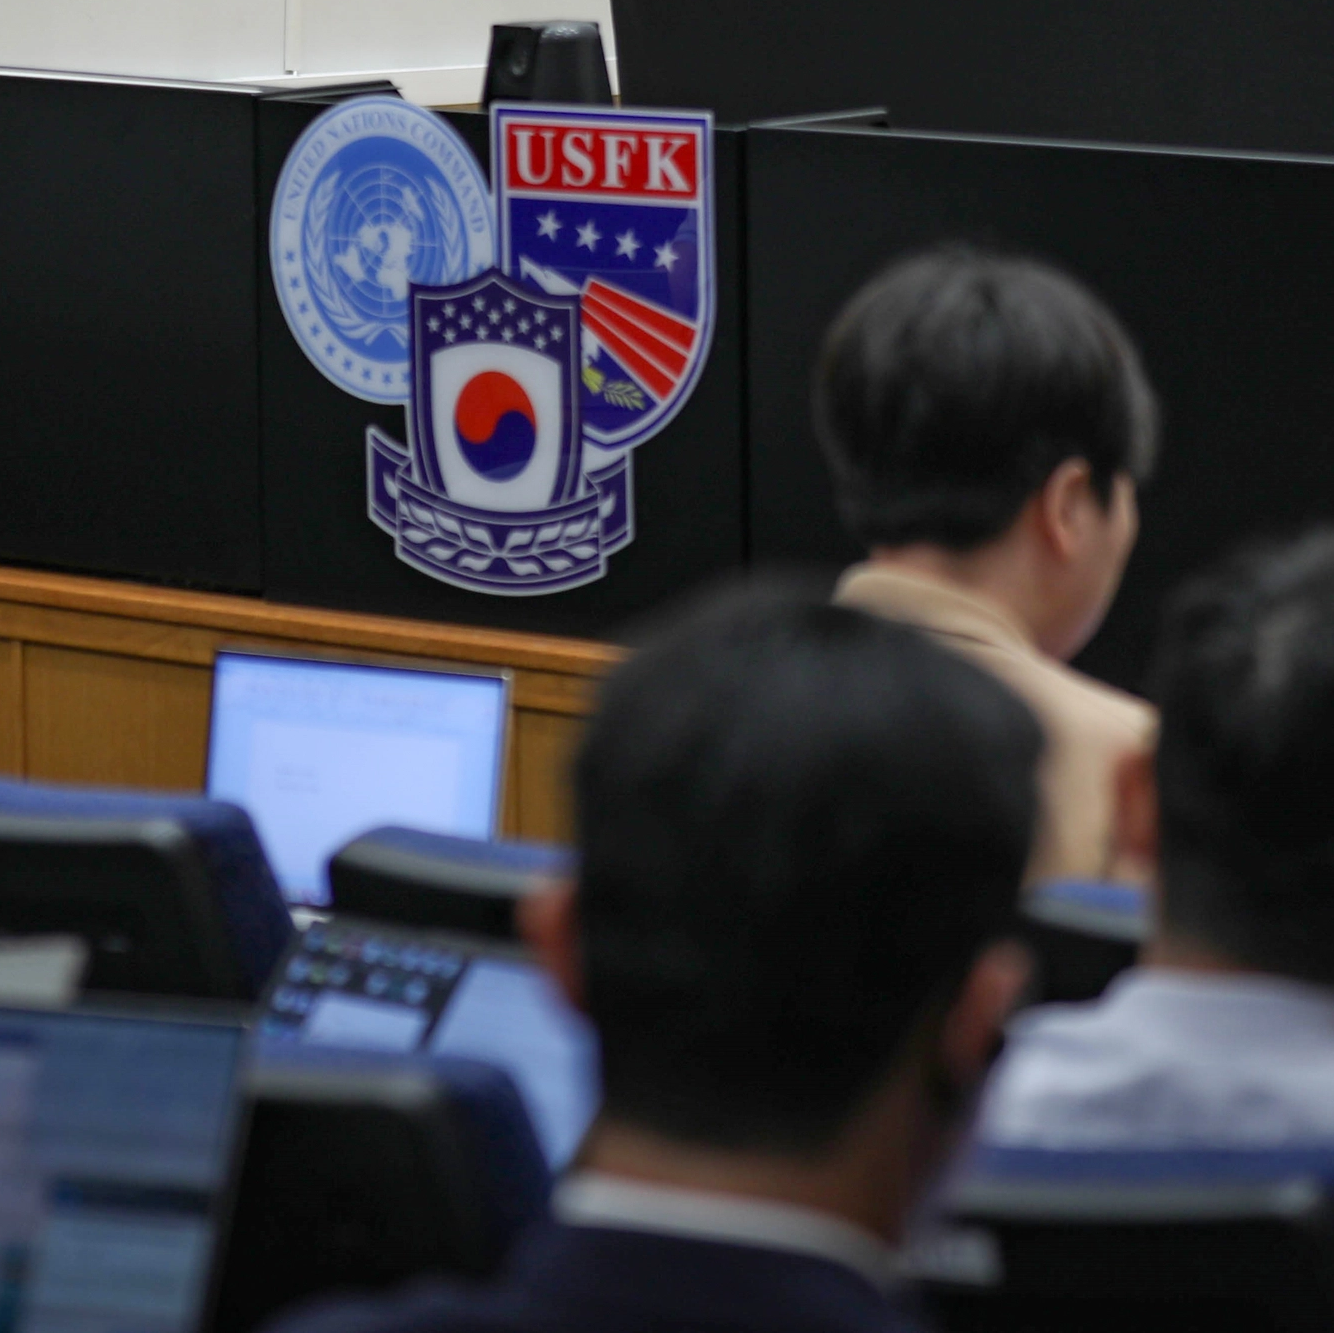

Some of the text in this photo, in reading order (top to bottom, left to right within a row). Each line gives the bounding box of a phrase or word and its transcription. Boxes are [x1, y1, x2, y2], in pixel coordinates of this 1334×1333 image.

[284, 111, 486, 233] UNITED NATIONS COMMAND
[513, 129, 693, 192] USFK
